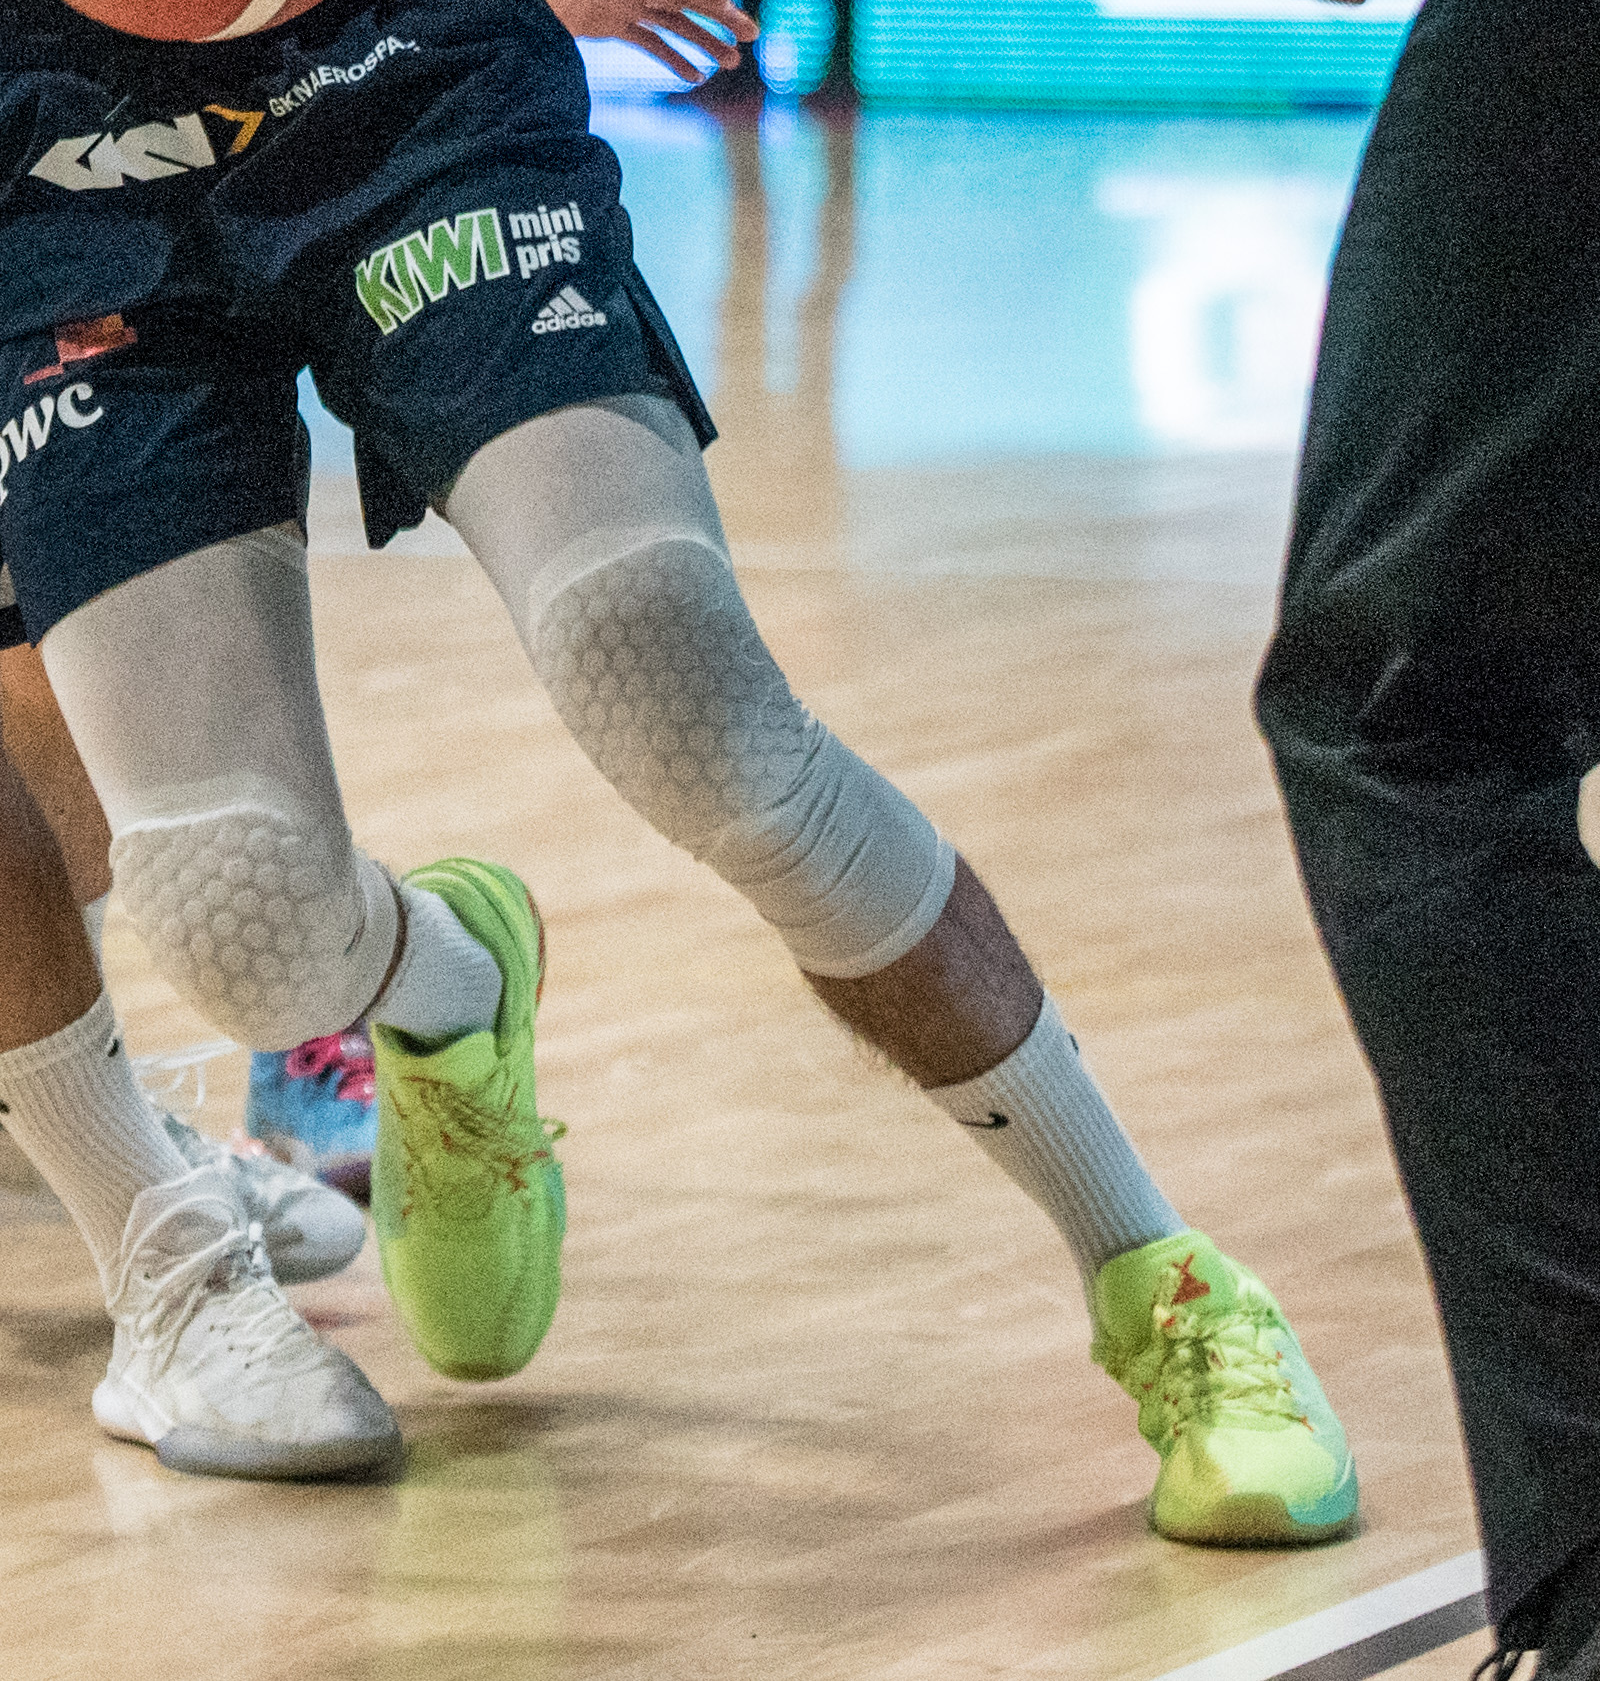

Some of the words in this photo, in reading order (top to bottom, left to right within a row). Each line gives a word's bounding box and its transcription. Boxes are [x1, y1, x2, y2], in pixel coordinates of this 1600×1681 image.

[508, 201, 584, 240] mini
[353, 207, 510, 336] KIWI
[515, 233, 581, 280] pris
[531, 311, 608, 335] adidas
